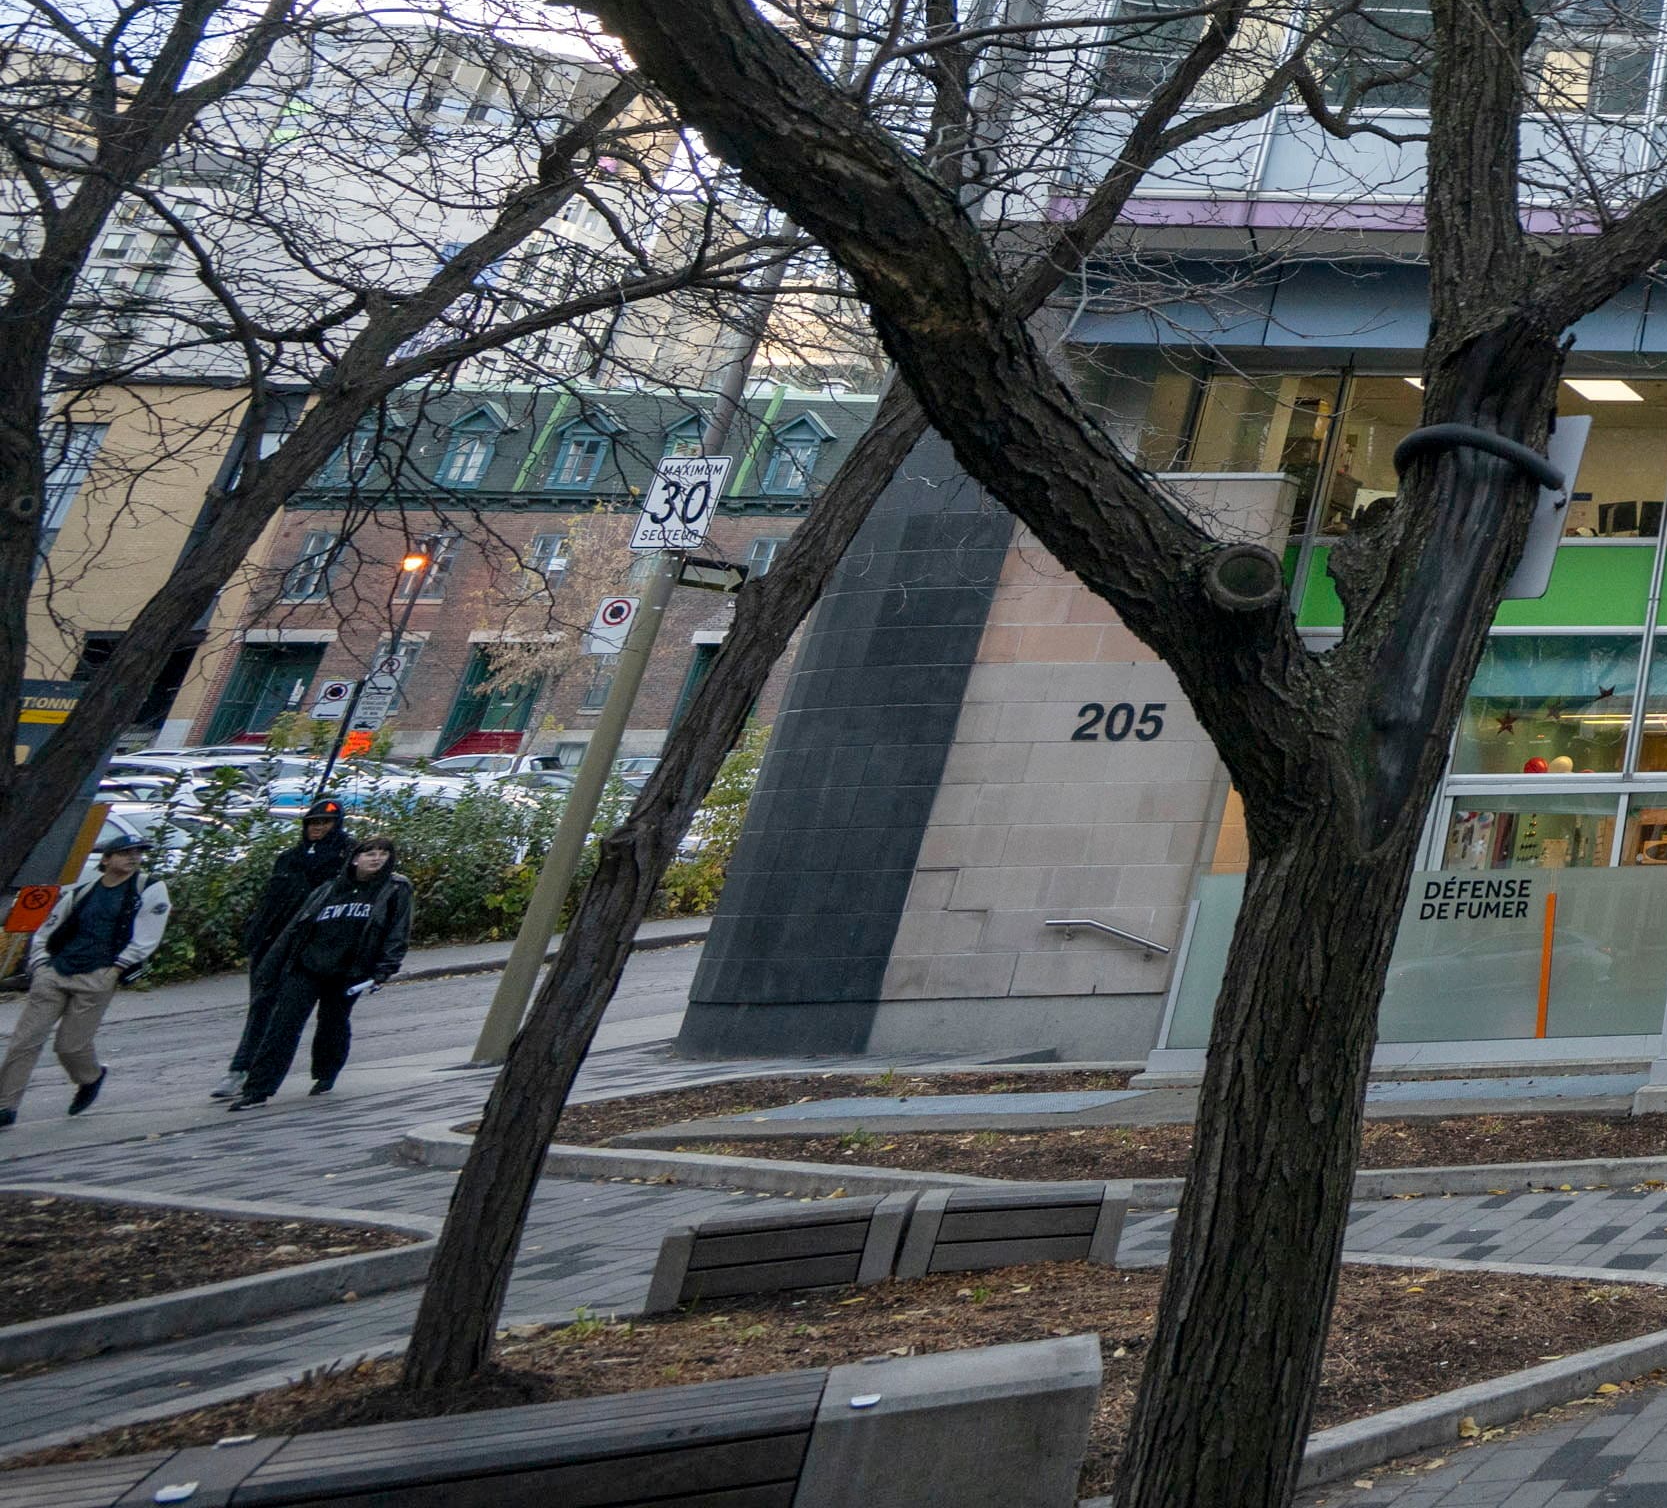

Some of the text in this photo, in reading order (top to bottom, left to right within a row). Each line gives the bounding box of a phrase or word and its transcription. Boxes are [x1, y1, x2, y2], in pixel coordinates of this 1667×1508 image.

[664, 464, 724, 476] MAXIMUM
[650, 481, 711, 524] 30
[640, 529, 700, 541] SECTEUR
[1071, 702, 1167, 742] 205
[1424, 876, 1532, 900] DÉFENSE
[1420, 900, 1529, 920] DE FUMER
